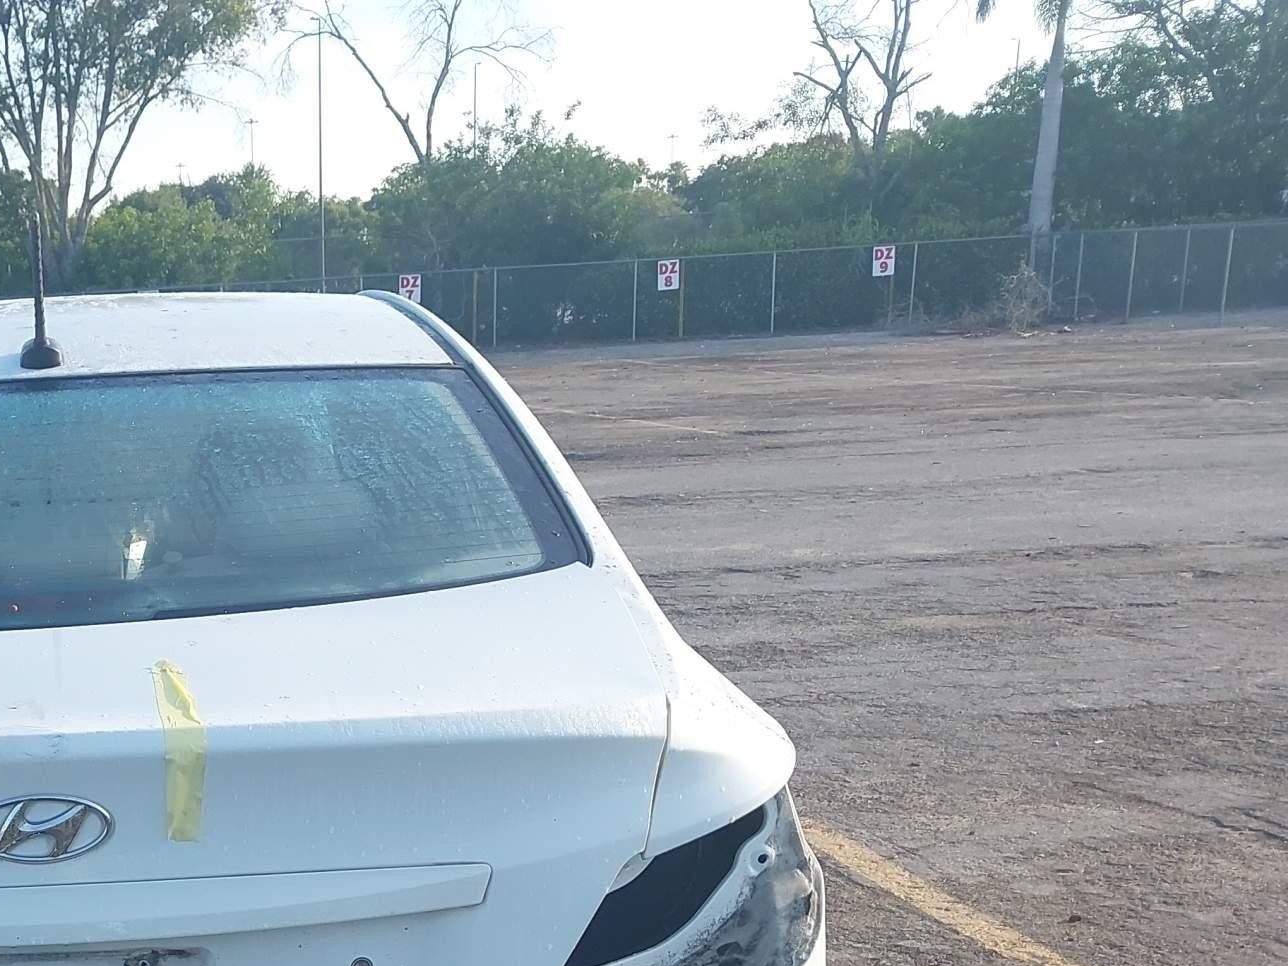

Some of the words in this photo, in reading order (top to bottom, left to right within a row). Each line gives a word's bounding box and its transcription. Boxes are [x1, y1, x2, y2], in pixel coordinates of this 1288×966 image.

[874, 248, 894, 261] DZ
[659, 261, 678, 275] DZ
[879, 261, 889, 273] 9
[400, 275, 420, 289] DZ
[664, 275, 673, 287] 8
[405, 289, 415, 300] 7
